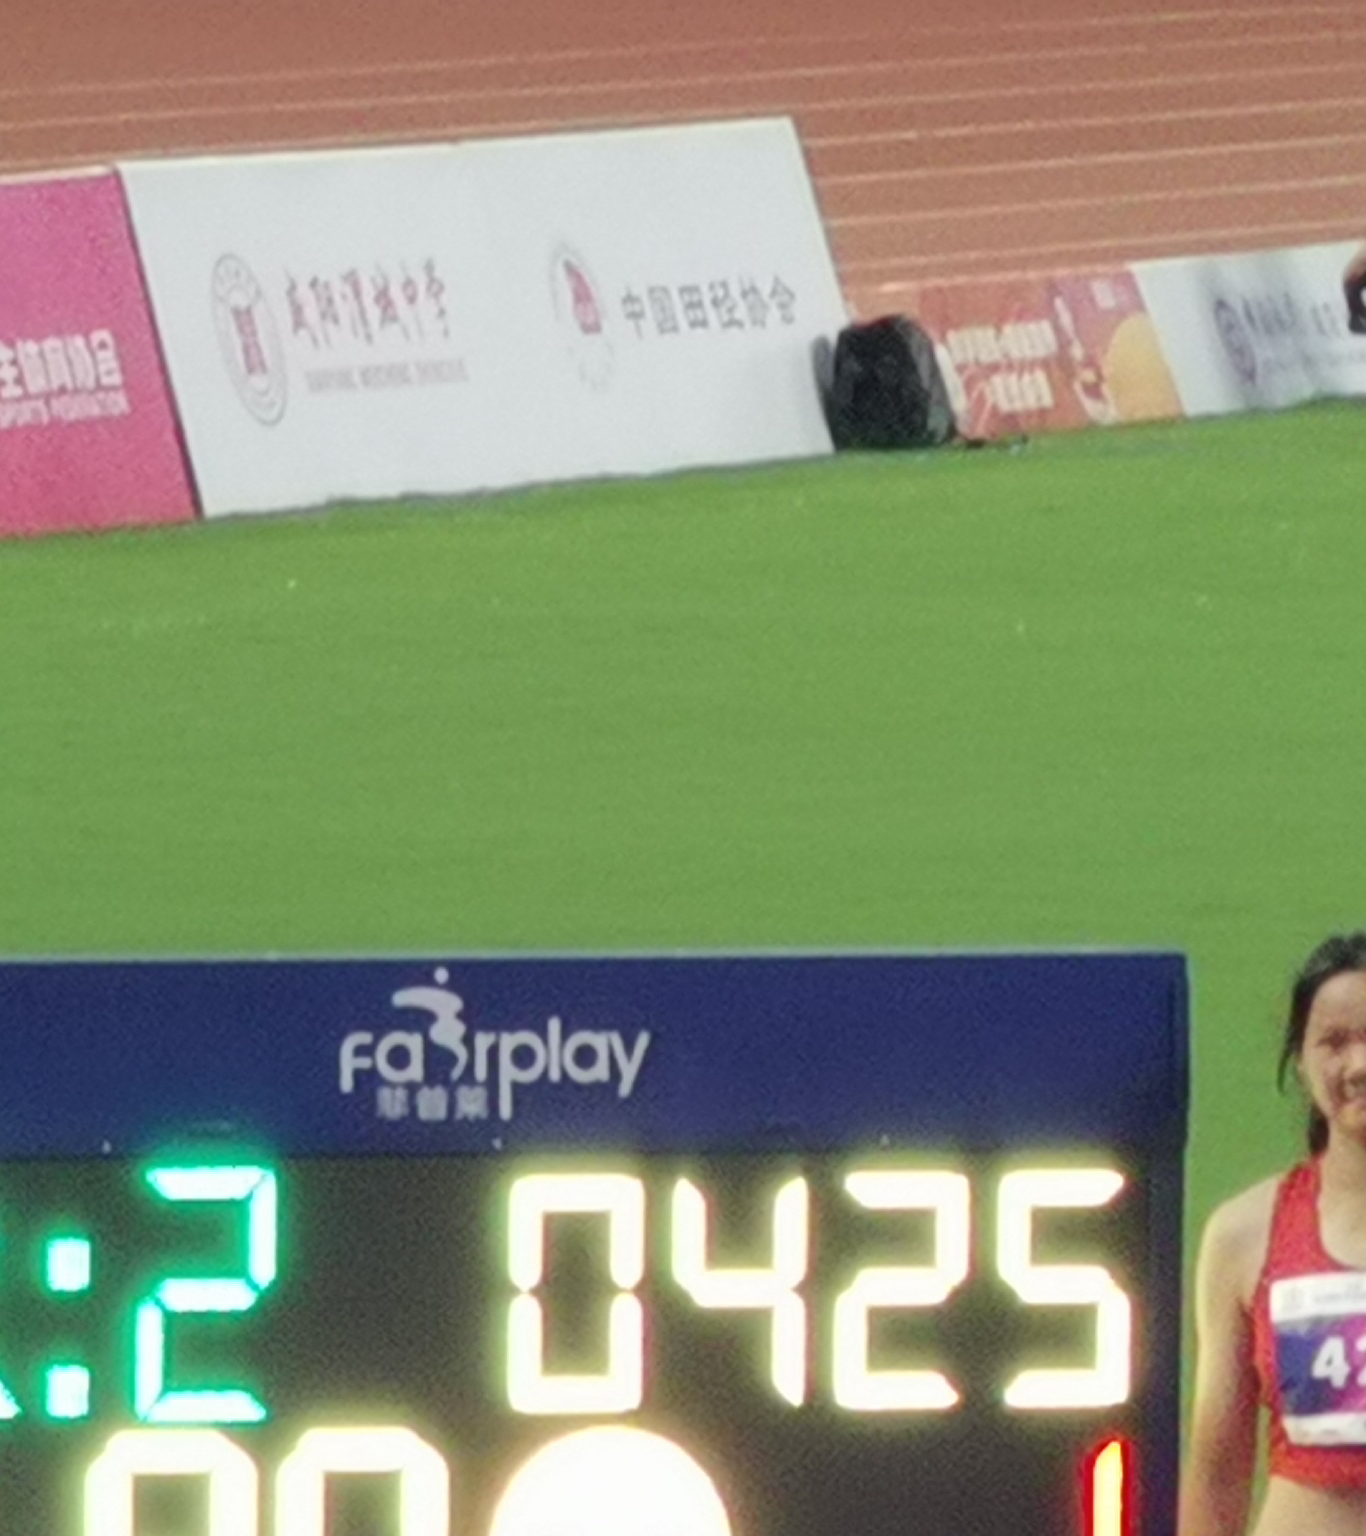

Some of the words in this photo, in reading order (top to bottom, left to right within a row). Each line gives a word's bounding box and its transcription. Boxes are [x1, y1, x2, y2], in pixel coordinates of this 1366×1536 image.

[621, 274, 796, 339] 中国田径协会
[506, 1168, 1131, 1415] 0425
